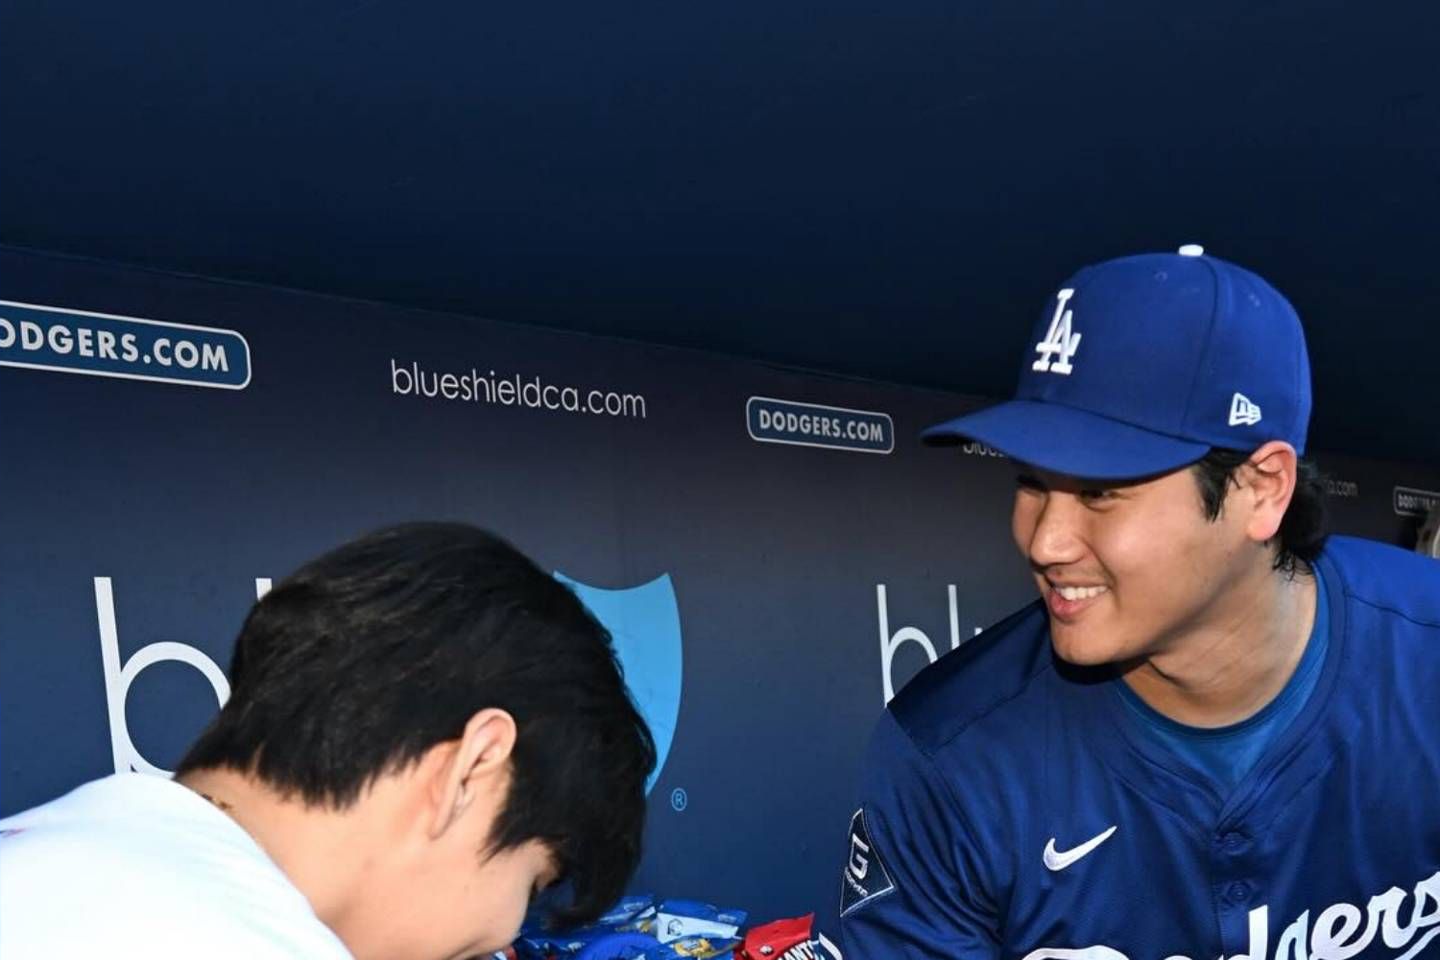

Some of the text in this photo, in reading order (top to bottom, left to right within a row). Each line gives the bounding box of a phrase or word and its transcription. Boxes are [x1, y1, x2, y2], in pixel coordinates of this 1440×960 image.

[1032, 288, 1082, 376] LA
[391, 358, 647, 418] blueshieldca.com
[759, 408, 885, 442] DODGERS.COM
